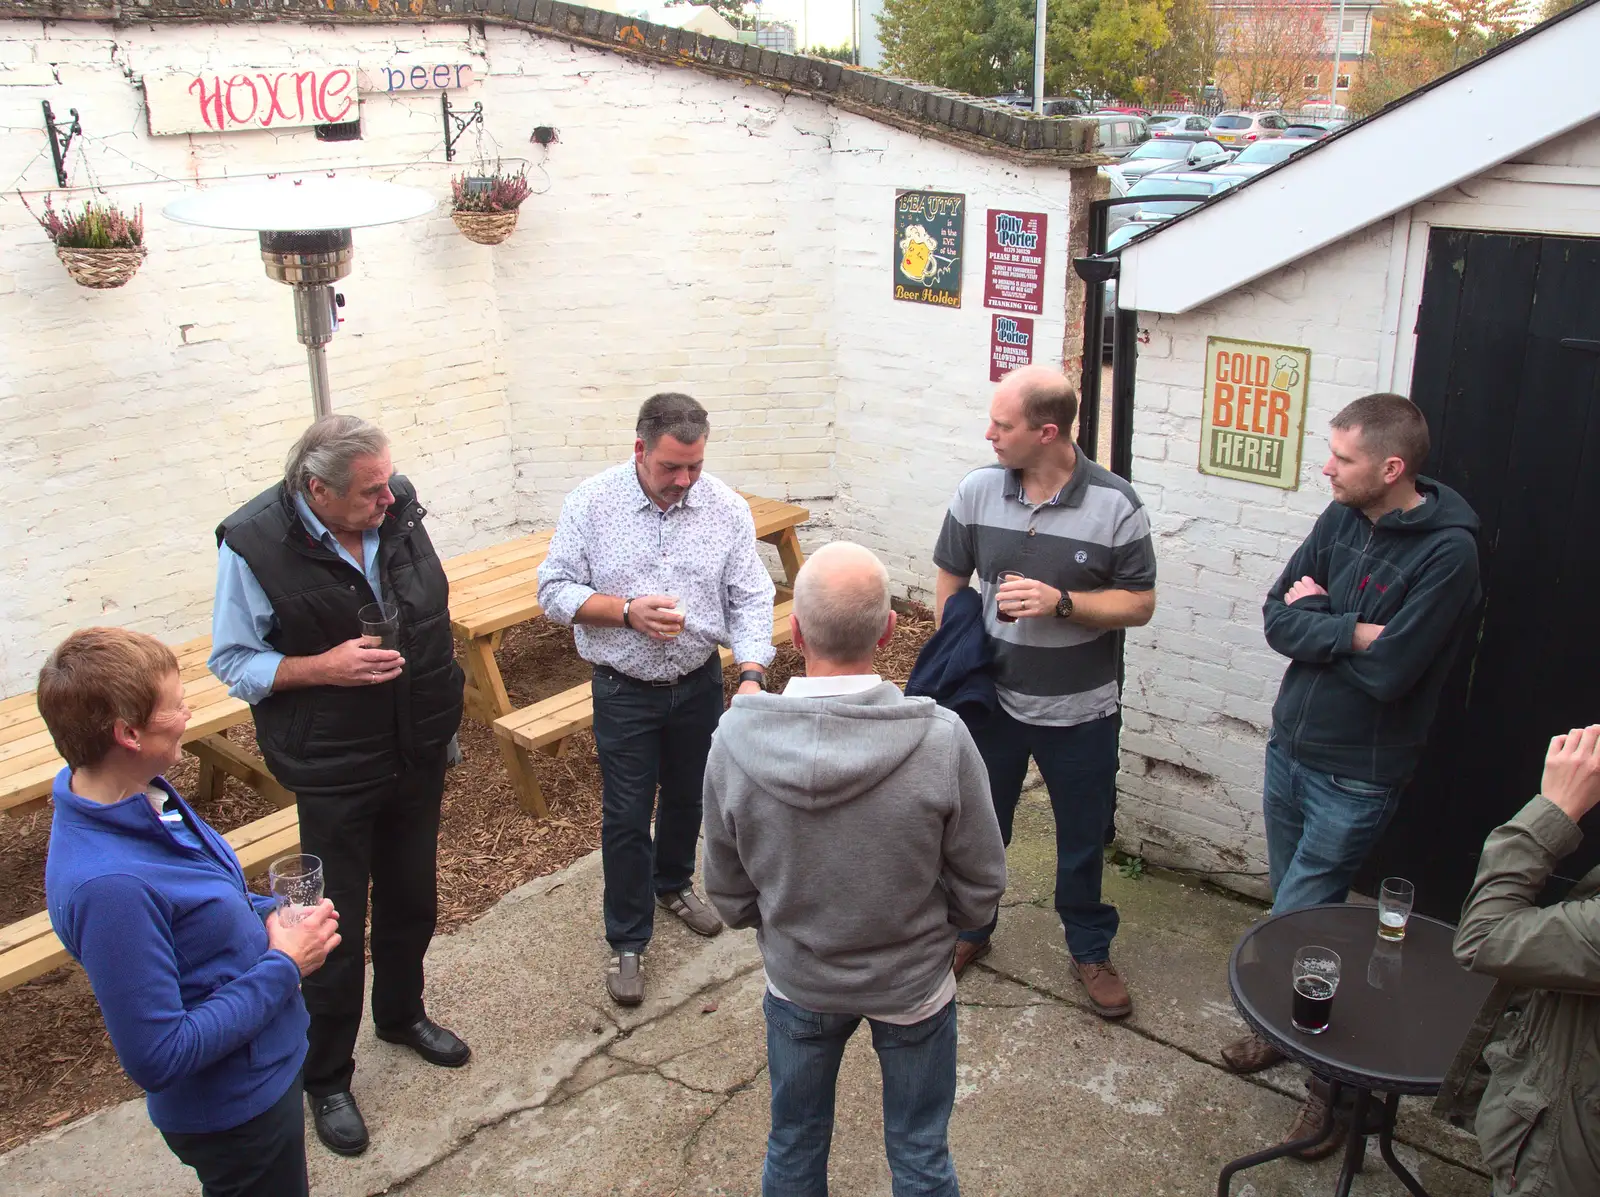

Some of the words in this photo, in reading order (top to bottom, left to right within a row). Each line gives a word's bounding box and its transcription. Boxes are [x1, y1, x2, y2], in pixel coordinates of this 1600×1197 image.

[899, 194, 961, 221] BEAUTY
[947, 219, 953, 227] is
[996, 216, 1022, 233] Jolly
[941, 228, 947, 236] in
[947, 229, 957, 237] the
[942, 237, 955, 246] EYE
[1000, 231, 1037, 248] Porter
[940, 247, 946, 255] of
[947, 247, 957, 256] the
[989, 252, 1011, 261] PLEASE
[1011, 254, 1020, 262] BE
[1021, 255, 1042, 265] AWARE
[895, 285, 920, 301] Beer
[921, 287, 959, 306] Holder
[988, 299, 1022, 309] THANKING
[997, 318, 1017, 333] Jolly
[999, 330, 1028, 344] Porter
[995, 345, 1003, 353] NO
[1003, 346, 1028, 357] DRINKING
[993, 352, 1017, 362] ALLOWED
[1016, 356, 1029, 365] PAST
[996, 360, 1008, 368] THIS
[1215, 351, 1270, 387] COLD
[1212, 382, 1291, 437] BEER
[1215, 432, 1280, 473] HERE!
